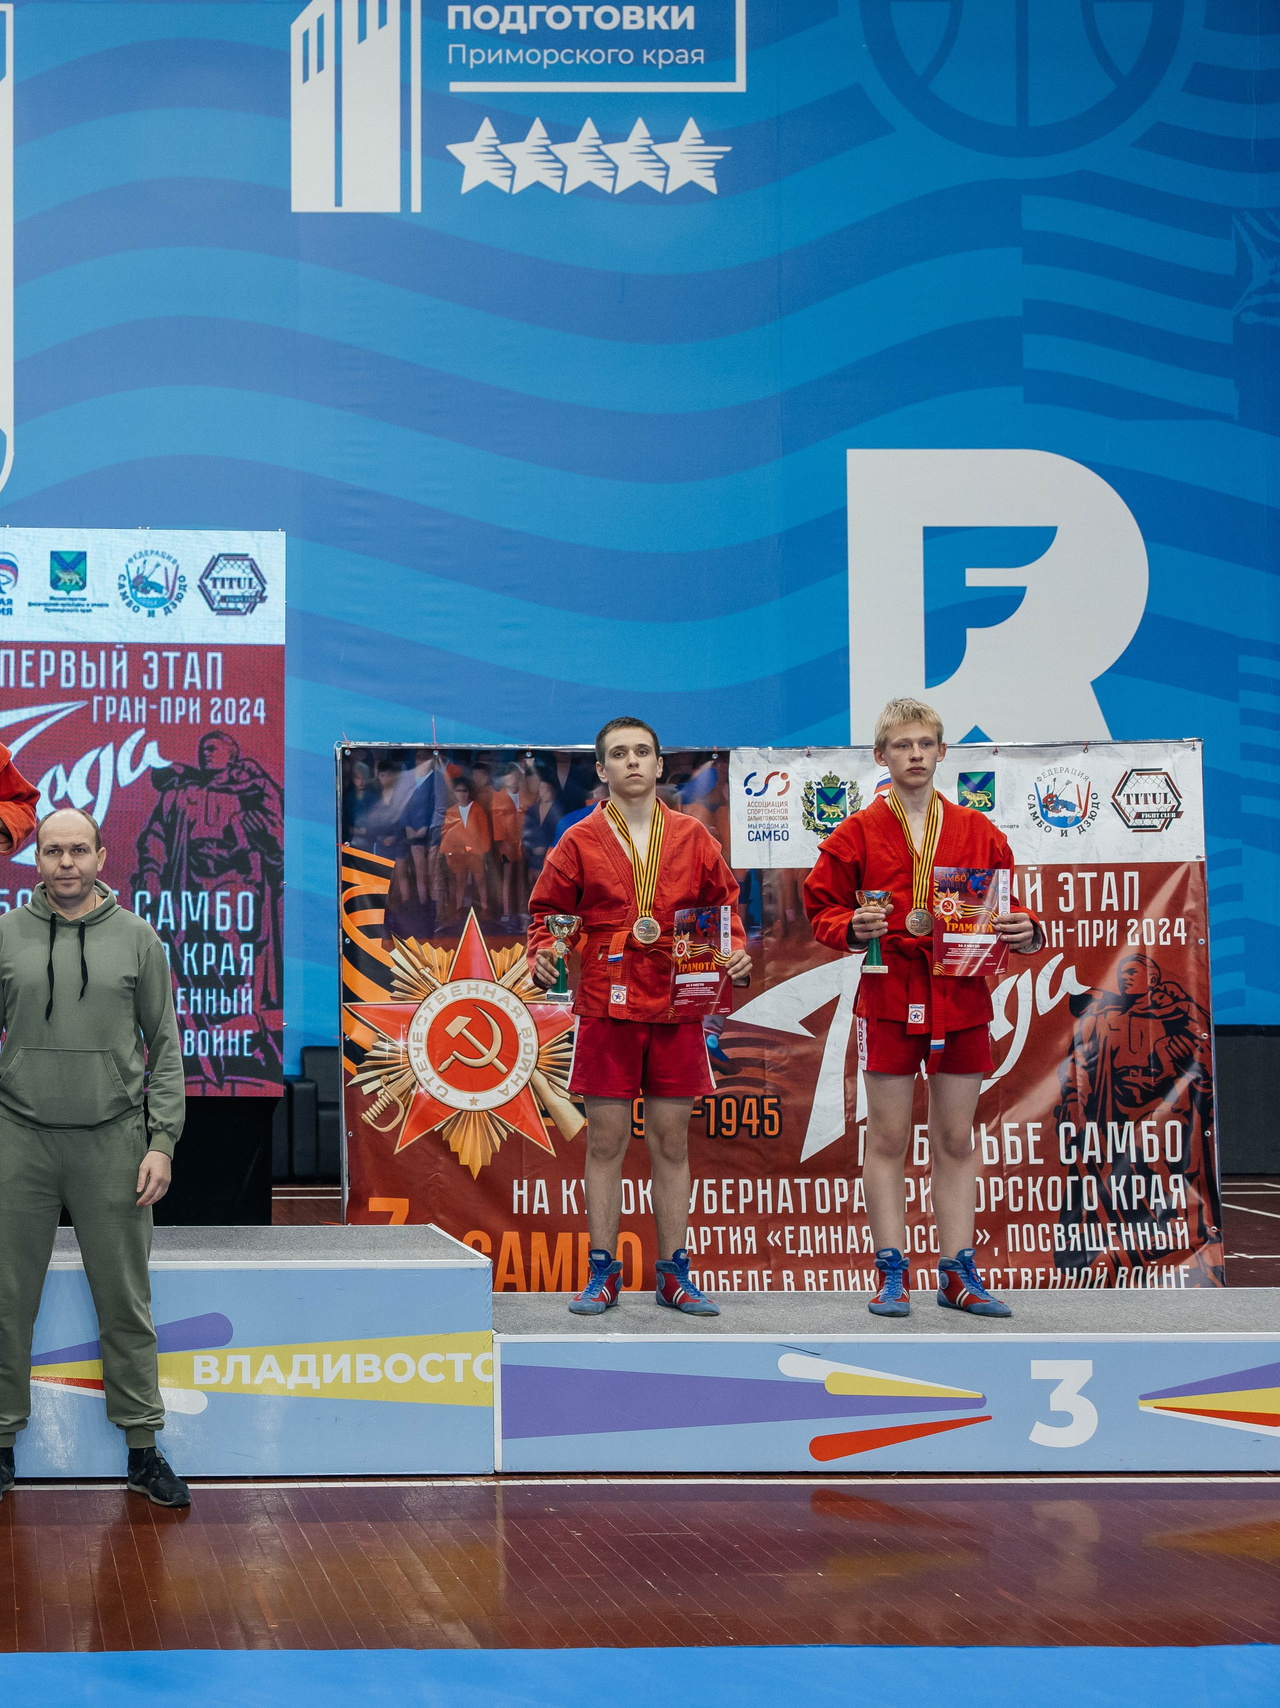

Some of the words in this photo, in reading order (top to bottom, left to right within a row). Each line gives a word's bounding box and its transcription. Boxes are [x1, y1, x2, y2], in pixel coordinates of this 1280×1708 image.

[447, 5, 695, 34] ПОДГОТОВКИ
[448, 43, 634, 69] Приморского
[642, 47, 705, 69] края
[209, 576, 257, 590] TITUL
[142, 650, 224, 691] ЭТАП
[91, 695, 202, 725] ГРАН-ПРИ
[209, 697, 267, 725] 2024
[1036, 767, 1090, 783] ФЕДЕРАЦИЯ
[747, 800, 789, 808] АССОЦИАЦИЯ
[1123, 792, 1172, 806] TITUL
[1027, 793, 1053, 834] САМБО
[1060, 829, 1069, 837] И
[1077, 792, 1101, 834] ДЗЮДО
[747, 830, 790, 841] САМБО
[1057, 871, 1140, 912] ЭТАП
[134, 890, 255, 932] САМБО
[945, 922, 994, 933] ГРАМОТА
[1126, 917, 1187, 946] 2024
[182, 942, 255, 977] КРАЯ
[677, 961, 717, 973] ГРАМОТА
[183, 1025, 254, 1058] ВОЙНЕ
[1058, 1120, 1183, 1164] САМБО
[512, 1179, 550, 1215] НА
[688, 1178, 868, 1215] УБЕРНАТОРА
[1110, 1173, 1188, 1211] КРАЯ
[685, 1226, 758, 1255] АРТИЯ
[1007, 1217, 1190, 1255] ПОСВЯЩЕННЫЙ
[1028, 1360, 1098, 1448] 3
